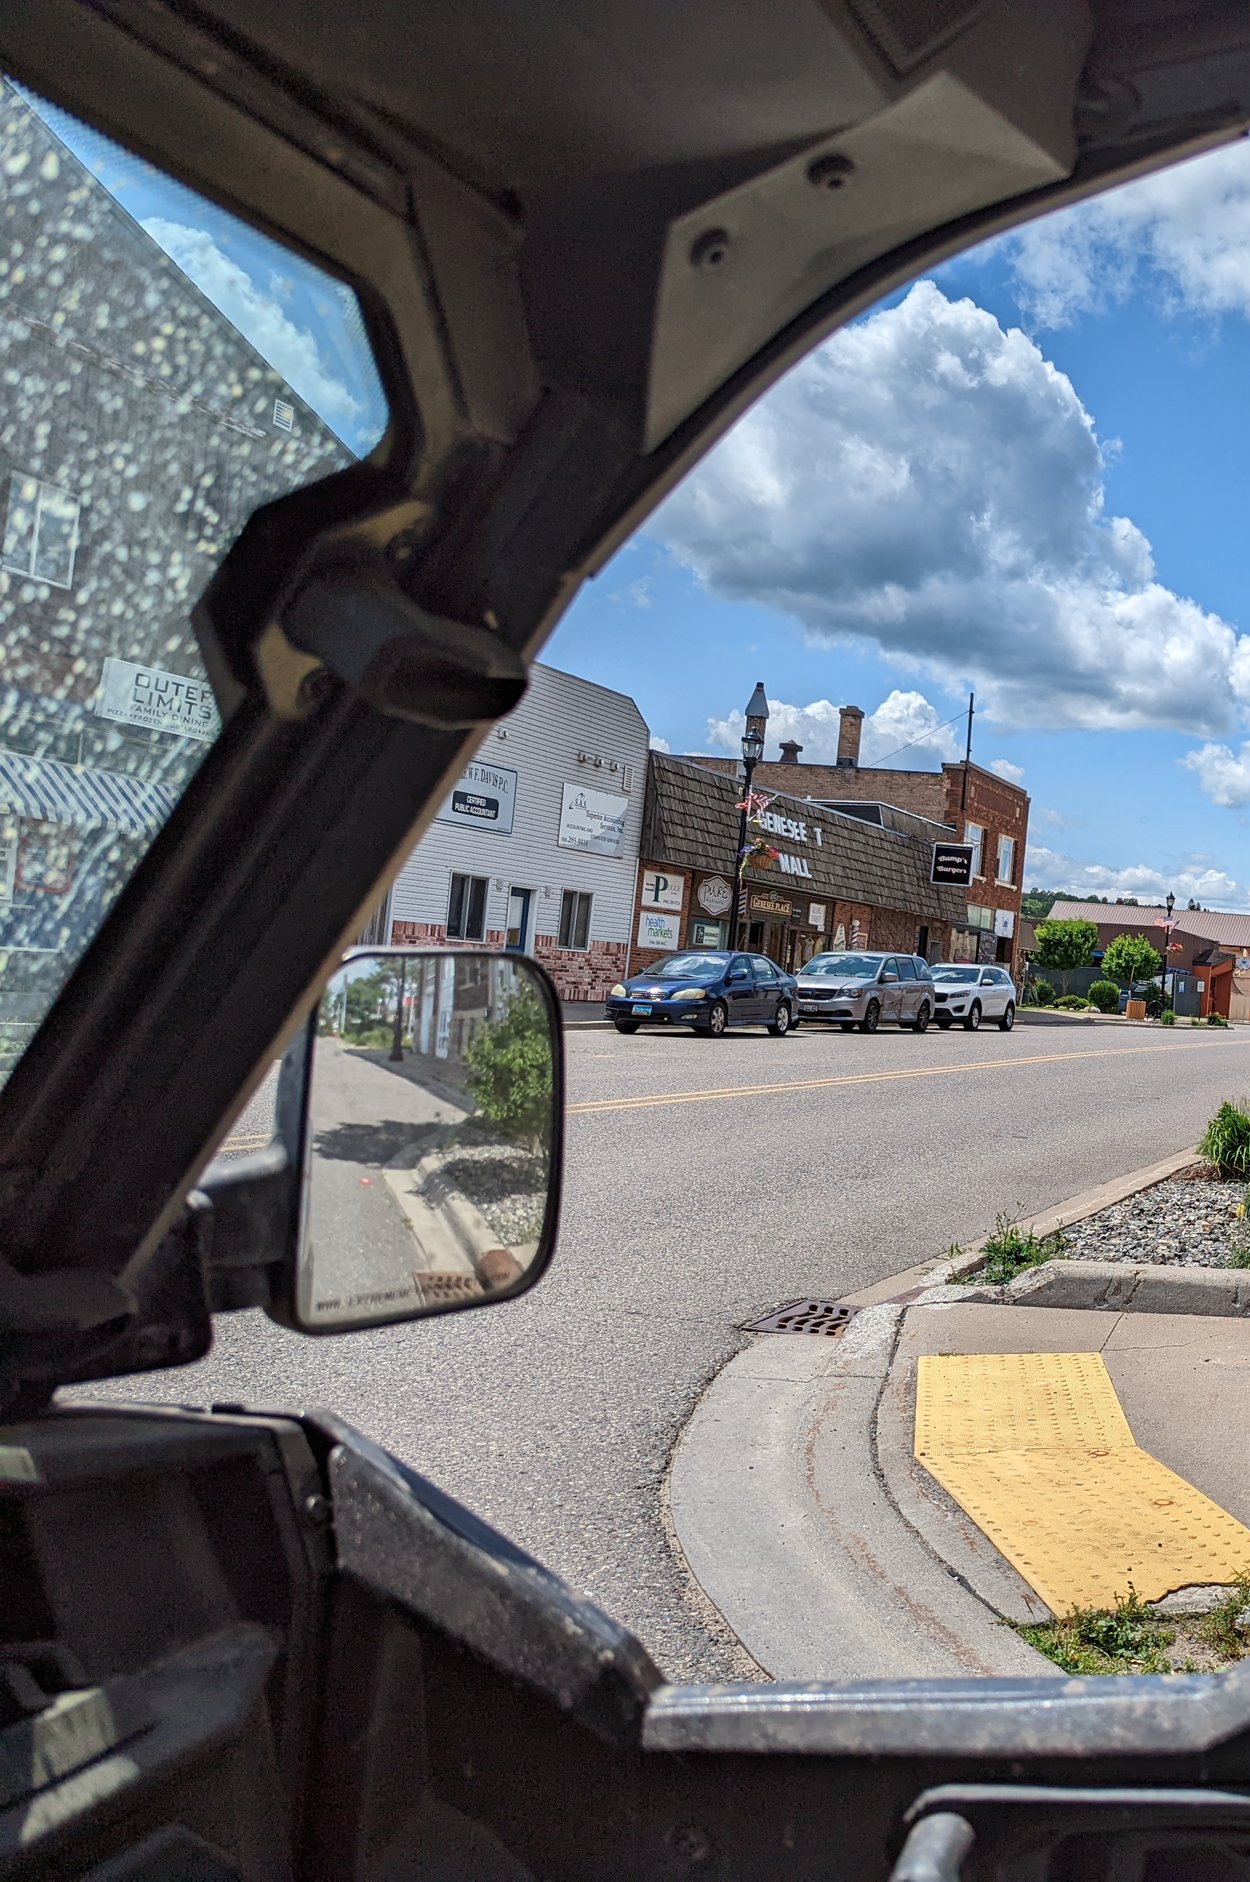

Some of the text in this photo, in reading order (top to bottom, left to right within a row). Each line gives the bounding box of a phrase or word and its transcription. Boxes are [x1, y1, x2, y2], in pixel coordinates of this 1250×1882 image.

[130, 703, 168, 718] FAMILY
[132, 687, 212, 720] LIMITS
[480, 768, 498, 788] DAVIS
[466, 795, 487, 807] CERTIFIED
[454, 802, 497, 819] PUBLIC ACCOUNTANT
[757, 808, 808, 842] GENESEE
[778, 852, 813, 879] MALL
[936, 865, 967, 874] Burgers
[753, 897, 775, 911] GENESEE
[775, 902, 791, 914] PLACE
[645, 914, 666, 929] health
[647, 926, 673, 939] markets
